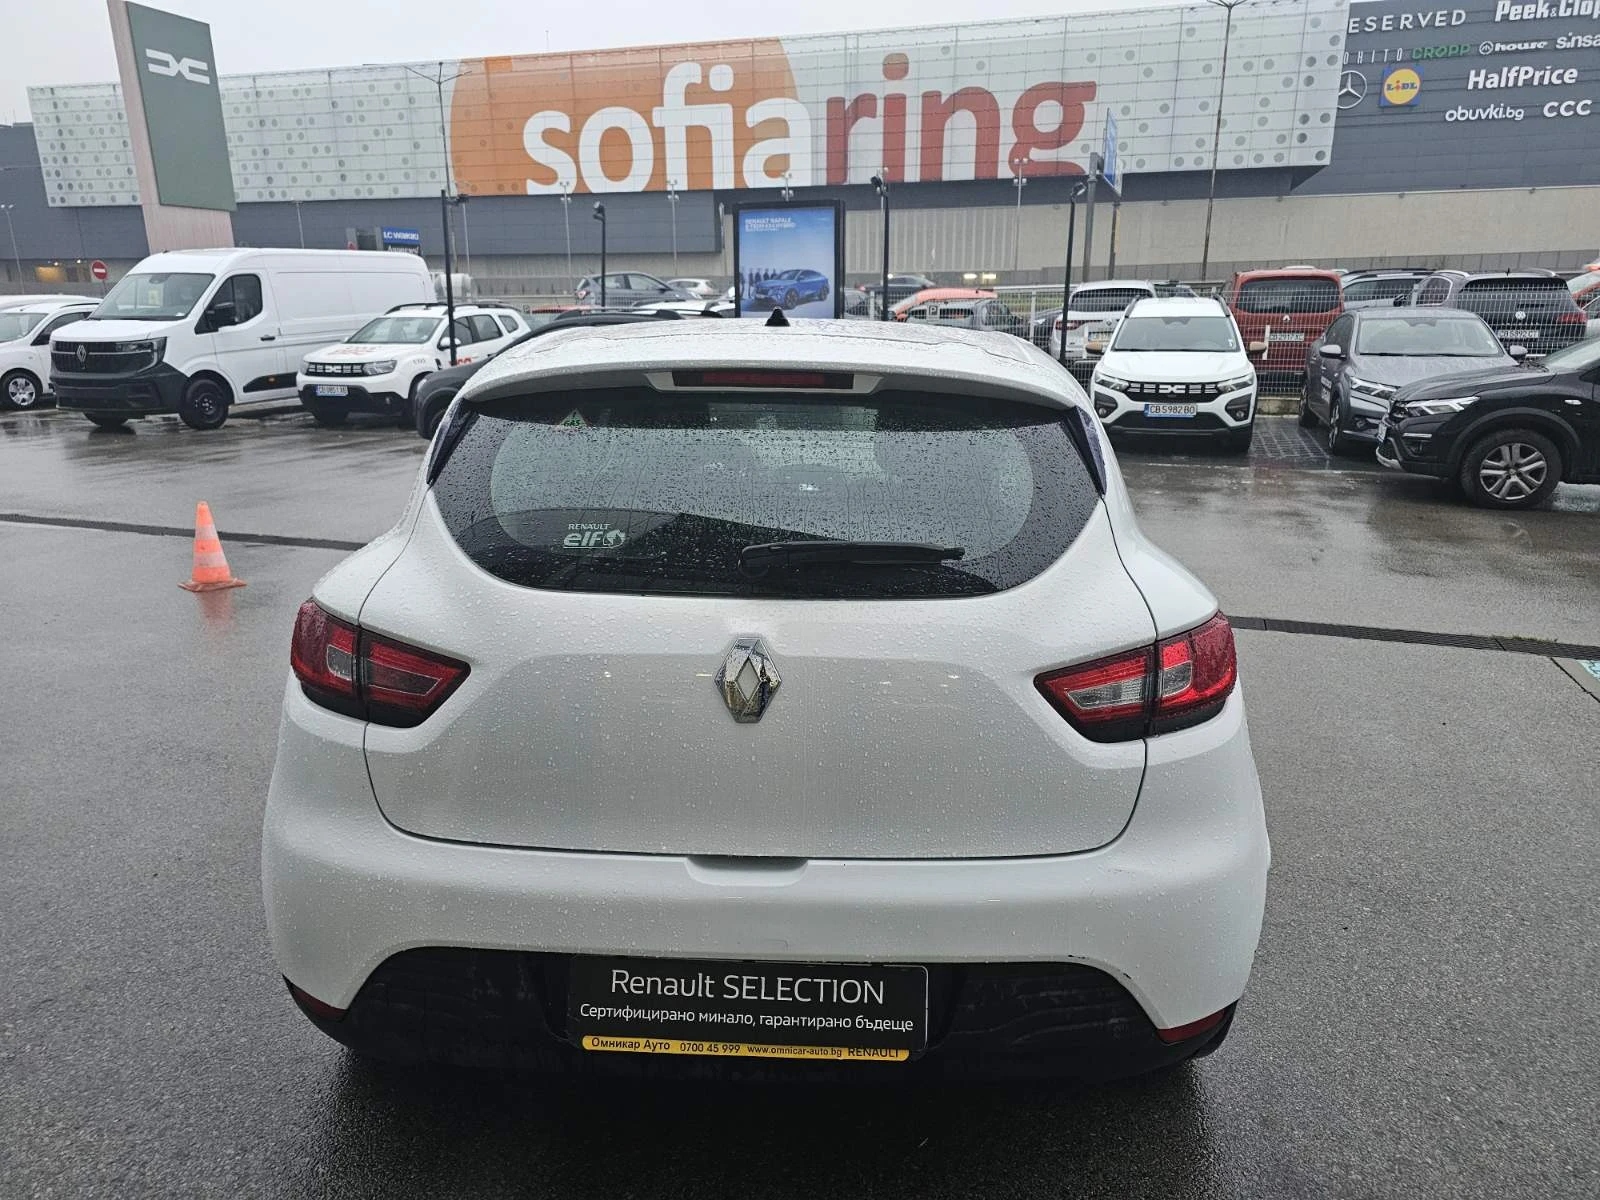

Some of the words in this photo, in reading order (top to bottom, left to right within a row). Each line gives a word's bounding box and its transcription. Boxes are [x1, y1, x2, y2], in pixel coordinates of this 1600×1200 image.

[1411, 44, 1471, 60] CROPP
[1467, 66, 1579, 90] HalfPrice
[1445, 103, 1525, 122] obuvki.bg
[1543, 99, 1593, 118] CCC
[563, 531, 604, 547] elf
[611, 969, 715, 998] Renault
[723, 975, 884, 1005] SELECTION
[580, 1003, 695, 1023] Сертифицирано
[698, 1012, 756, 1027] минало,
[759, 1015, 852, 1030] гарантирано
[855, 1015, 914, 1033] бъдеще
[591, 1037, 641, 1050] Омникар
[643, 1040, 671, 1053] Ауто
[680, 1042, 704, 1053] 0700
[707, 1043, 719, 1053] 45
[721, 1044, 741, 1054] 999
[747, 1045, 843, 1058] www.omnicar-auto.bg
